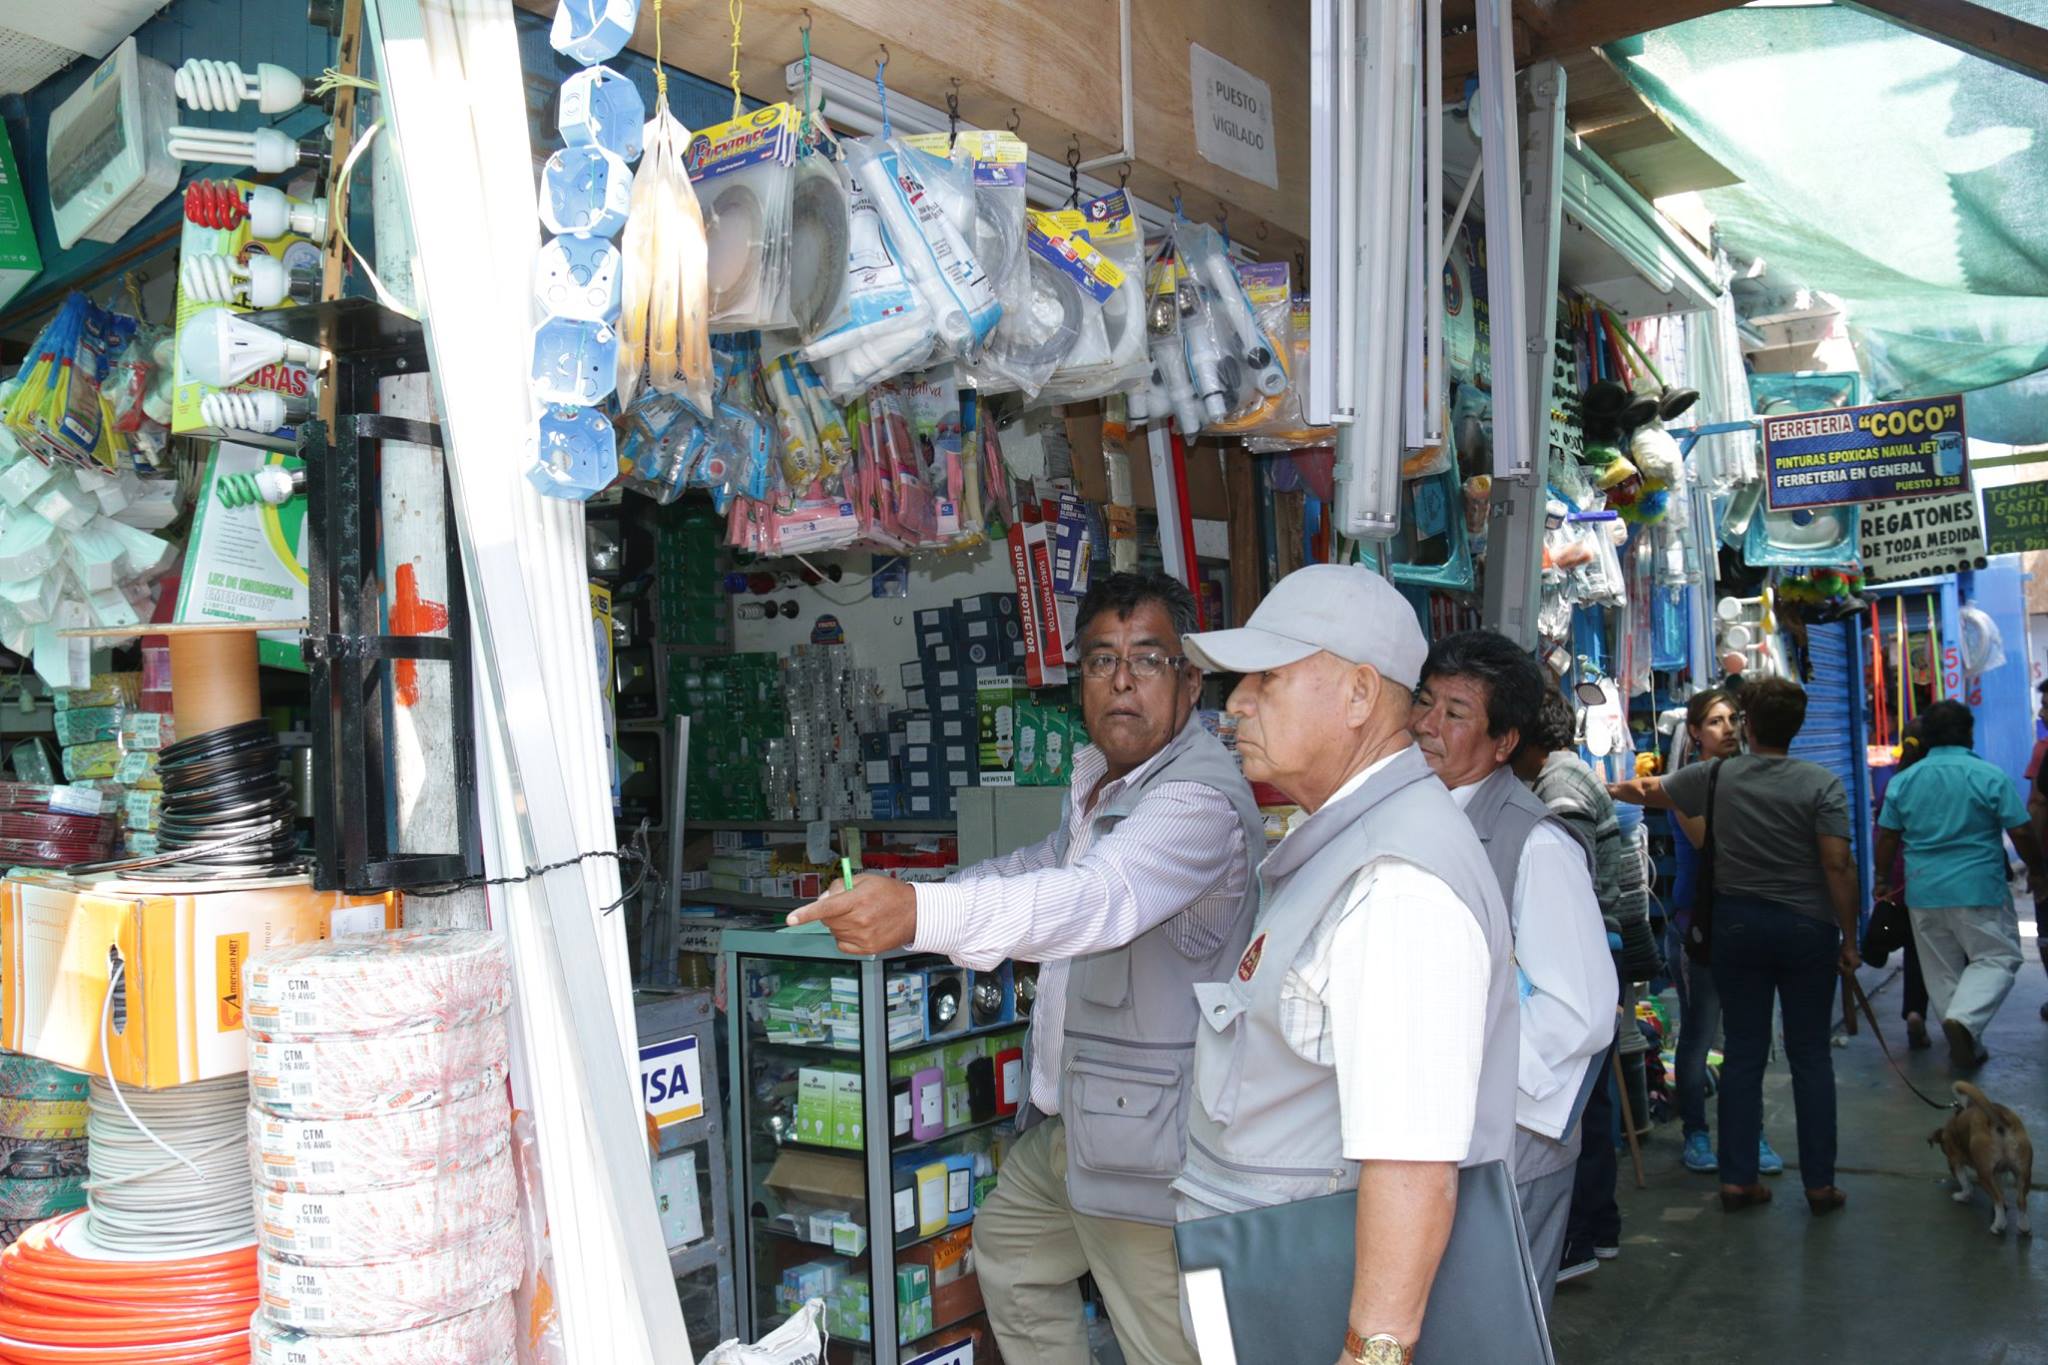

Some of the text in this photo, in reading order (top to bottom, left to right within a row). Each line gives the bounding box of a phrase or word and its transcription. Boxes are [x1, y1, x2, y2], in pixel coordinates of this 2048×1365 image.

[1216, 81, 1256, 114] PUESTO
[1213, 113, 1264, 150] VIGILADO
[1770, 415, 1851, 440] FERRETERIA
[1776, 441, 1938, 469] PINTURAS EPOXICAS NAVAL JET
[1777, 462, 1925, 487] FERRETERIA EN GENERAL
[1896, 480, 1933, 491] PUESTO
[1861, 500, 1973, 538] REGATONES
[1862, 542, 1881, 559] DE
[1884, 536, 1922, 556] TODA
[1927, 526, 1980, 548] MEDIDA
[1886, 551, 1928, 564] PUESTO
[239, 577, 294, 600] EMERGENCIA
[1014, 545, 1035, 653] SURGE PROTECTOR
[1039, 560, 1056, 633] SURGE PROTECTOR
[979, 678, 1009, 686] NEWSTAR
[982, 775, 1012, 783] NEWSTAR
[222, 958, 241, 1009] American
[288, 980, 309, 991] CTM
[298, 991, 316, 1000] AWG
[284, 1050, 303, 1061] CTM
[294, 1062, 310, 1071] AWG
[641, 1064, 690, 1104] ISA
[303, 1129, 324, 1140] CTM
[314, 1140, 332, 1149] AWG
[302, 1204, 323, 1215] CTM
[313, 1215, 330, 1224] AWG
[297, 1275, 316, 1286] CTM
[306, 1287, 322, 1296] AWG
[287, 1352, 307, 1363] CTM
